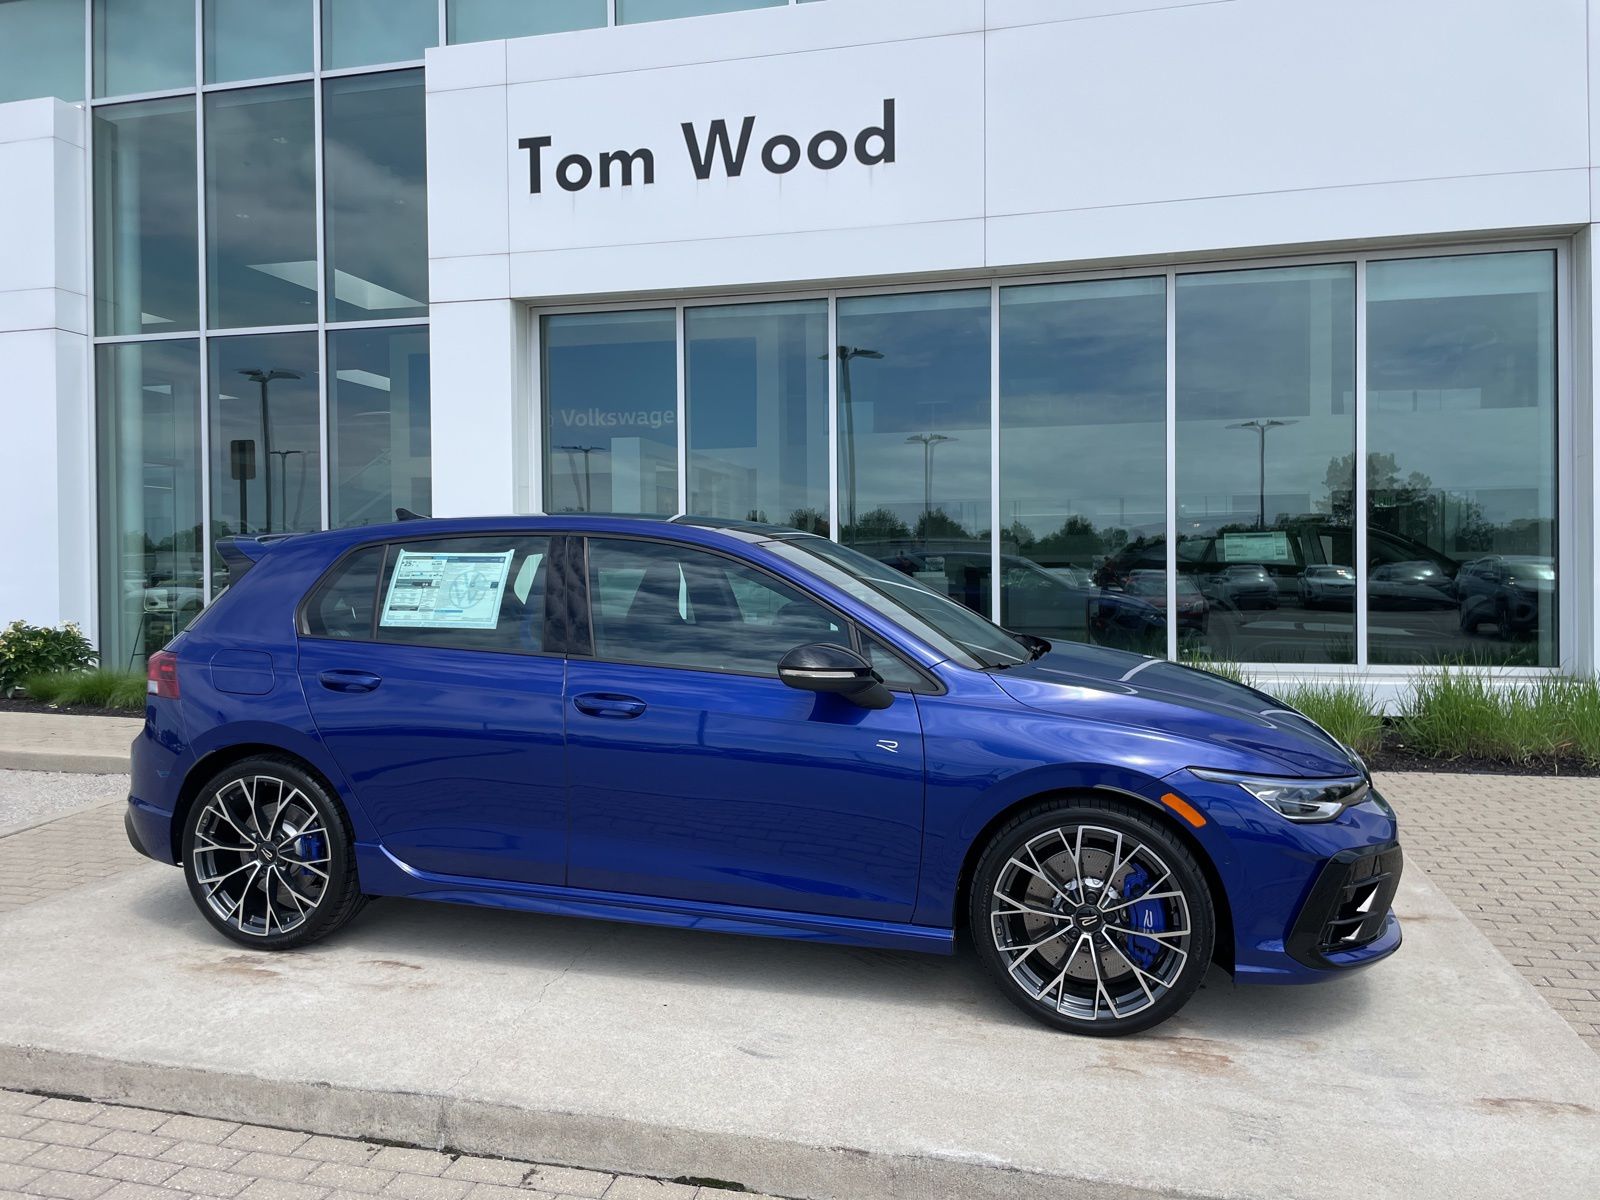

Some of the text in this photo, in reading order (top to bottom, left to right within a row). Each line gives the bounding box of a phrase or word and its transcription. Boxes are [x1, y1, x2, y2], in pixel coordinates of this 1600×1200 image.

[518, 98, 896, 194] Tom Wood
[561, 407, 676, 429] Volkswage
